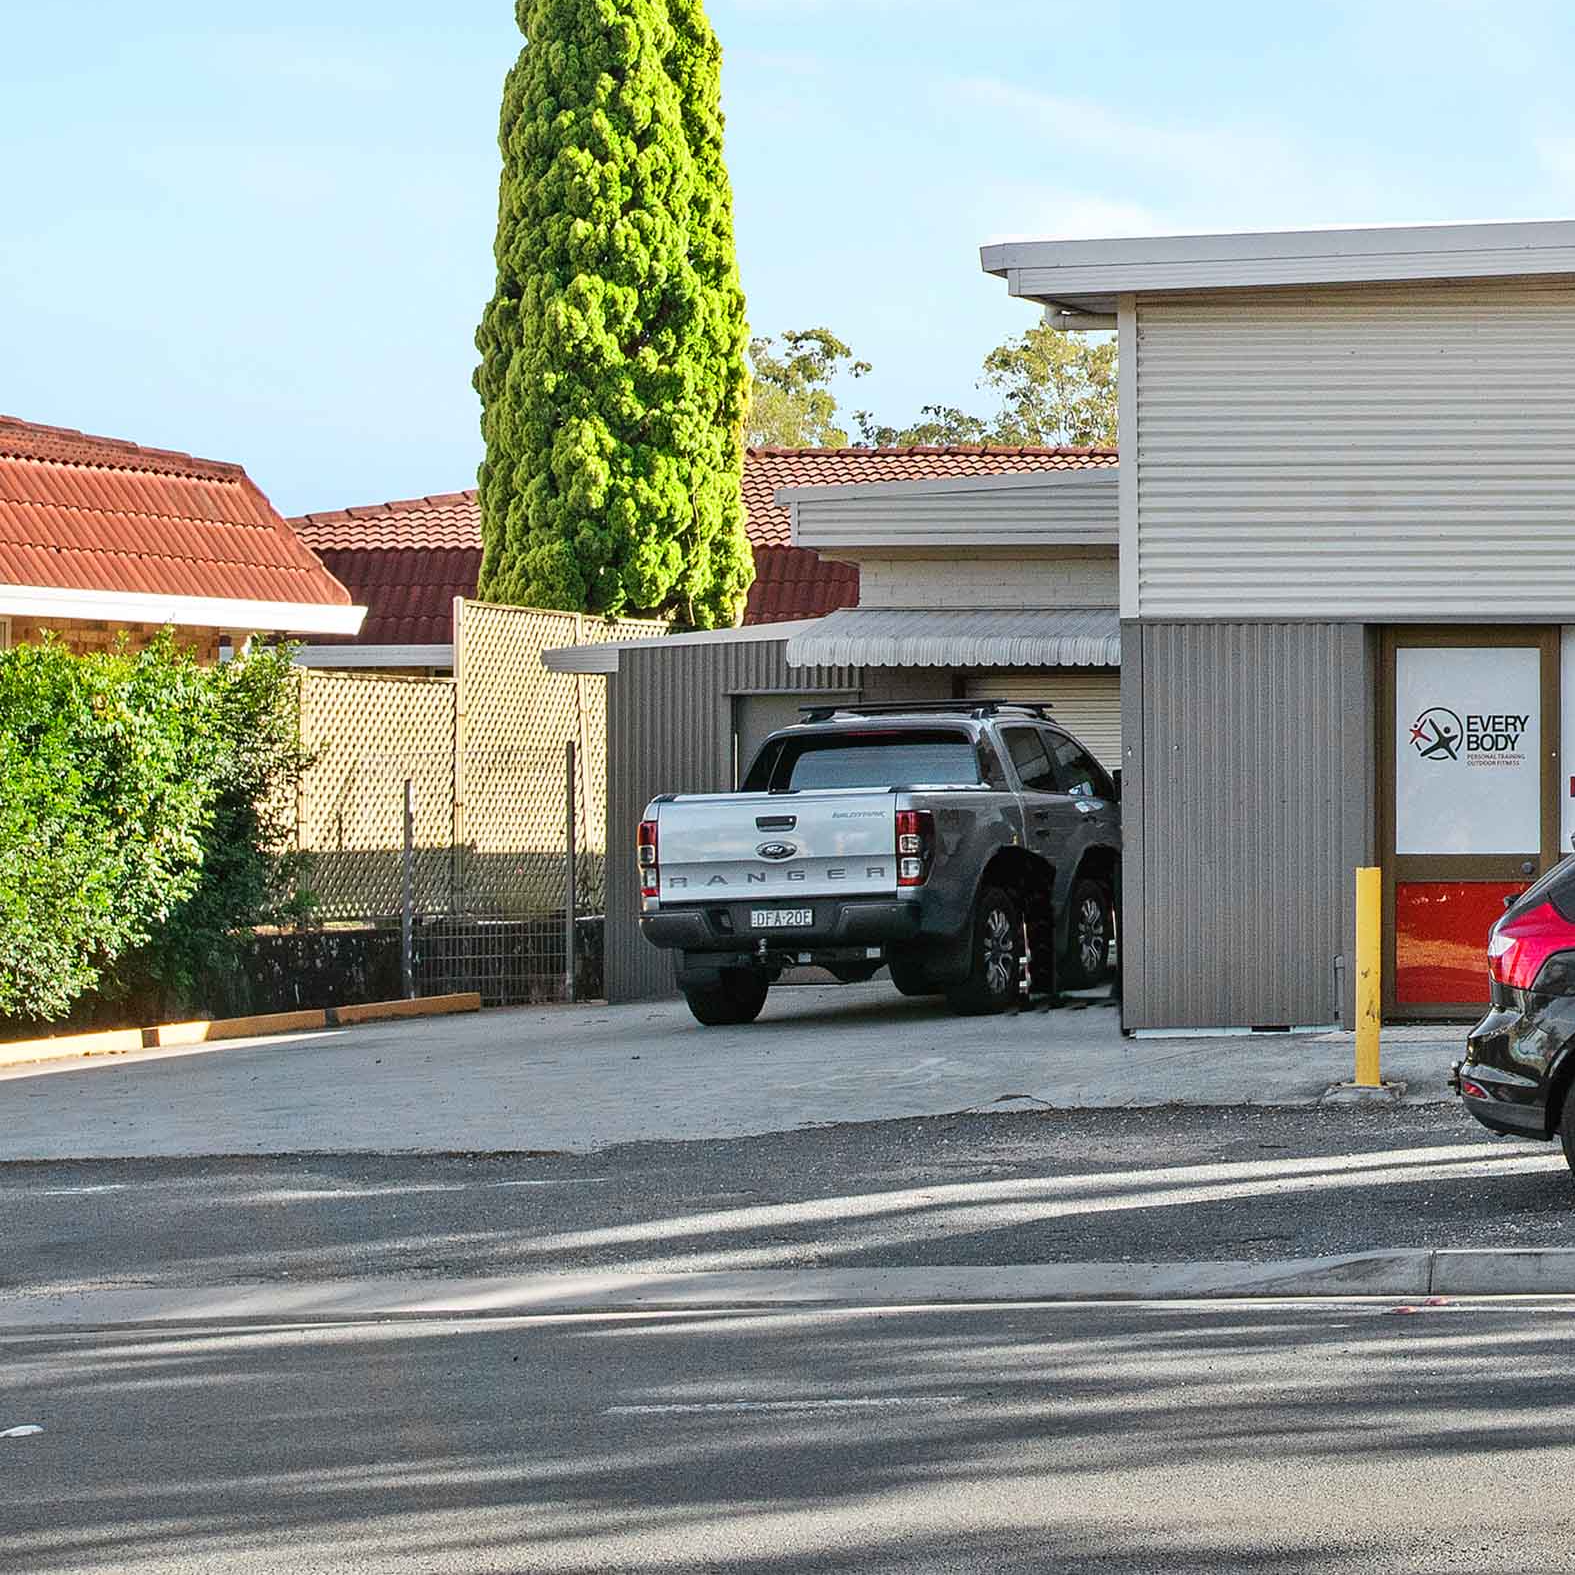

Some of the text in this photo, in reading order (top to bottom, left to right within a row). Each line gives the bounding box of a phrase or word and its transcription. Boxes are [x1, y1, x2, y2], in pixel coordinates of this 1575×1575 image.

[1466, 715, 1530, 732] EVERY
[1466, 733, 1520, 751] BODY
[669, 867, 885, 888] RANGER
